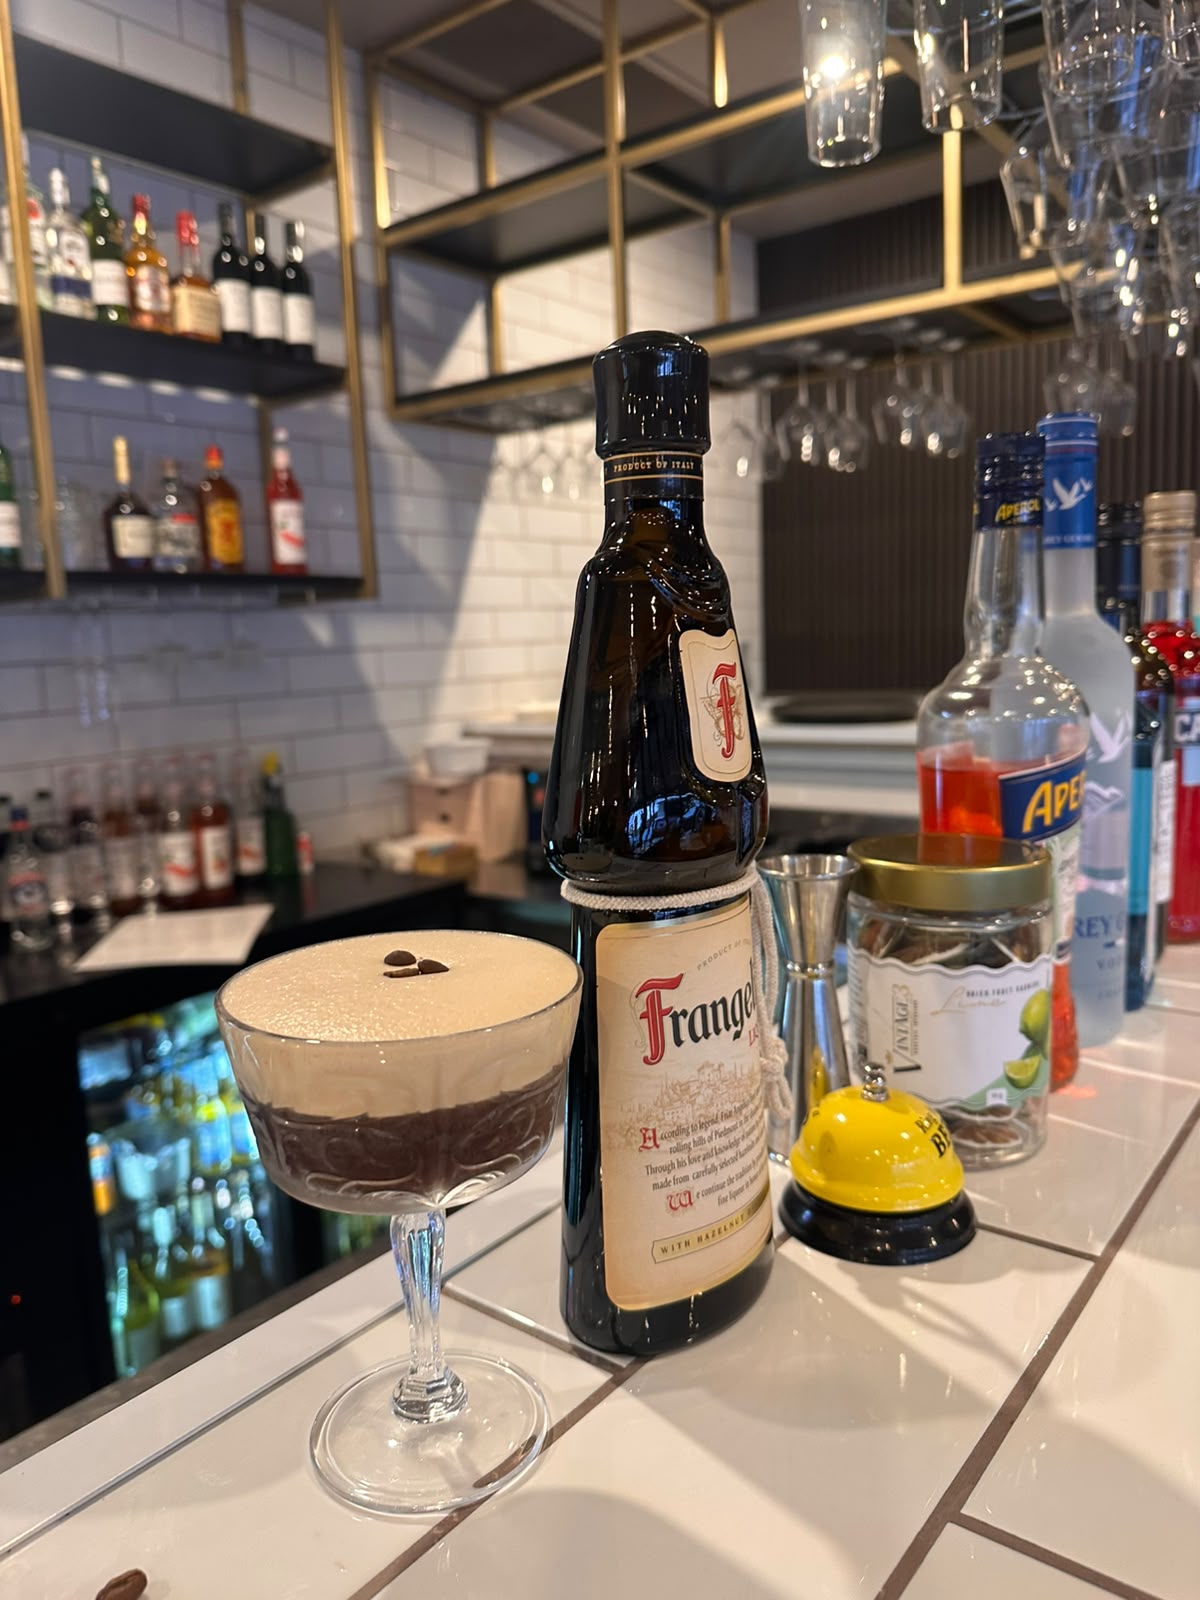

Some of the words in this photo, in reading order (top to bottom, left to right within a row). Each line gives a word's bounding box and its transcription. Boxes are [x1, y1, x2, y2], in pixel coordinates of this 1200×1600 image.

[613, 461, 652, 472] PRODUCT
[656, 460, 668, 469] OF
[672, 460, 694, 470] ITALY
[1175, 713, 1200, 743] CA
[1075, 916, 1113, 939] REY
[696, 944, 733, 971] PRODUCT
[635, 957, 757, 1066] Frangel
[645, 1161, 676, 1177] Through
[652, 1177, 672, 1191] made
[672, 1174, 690, 1188] from
[660, 1239, 691, 1255] WITH
[697, 1214, 745, 1243] HAZELNUT
